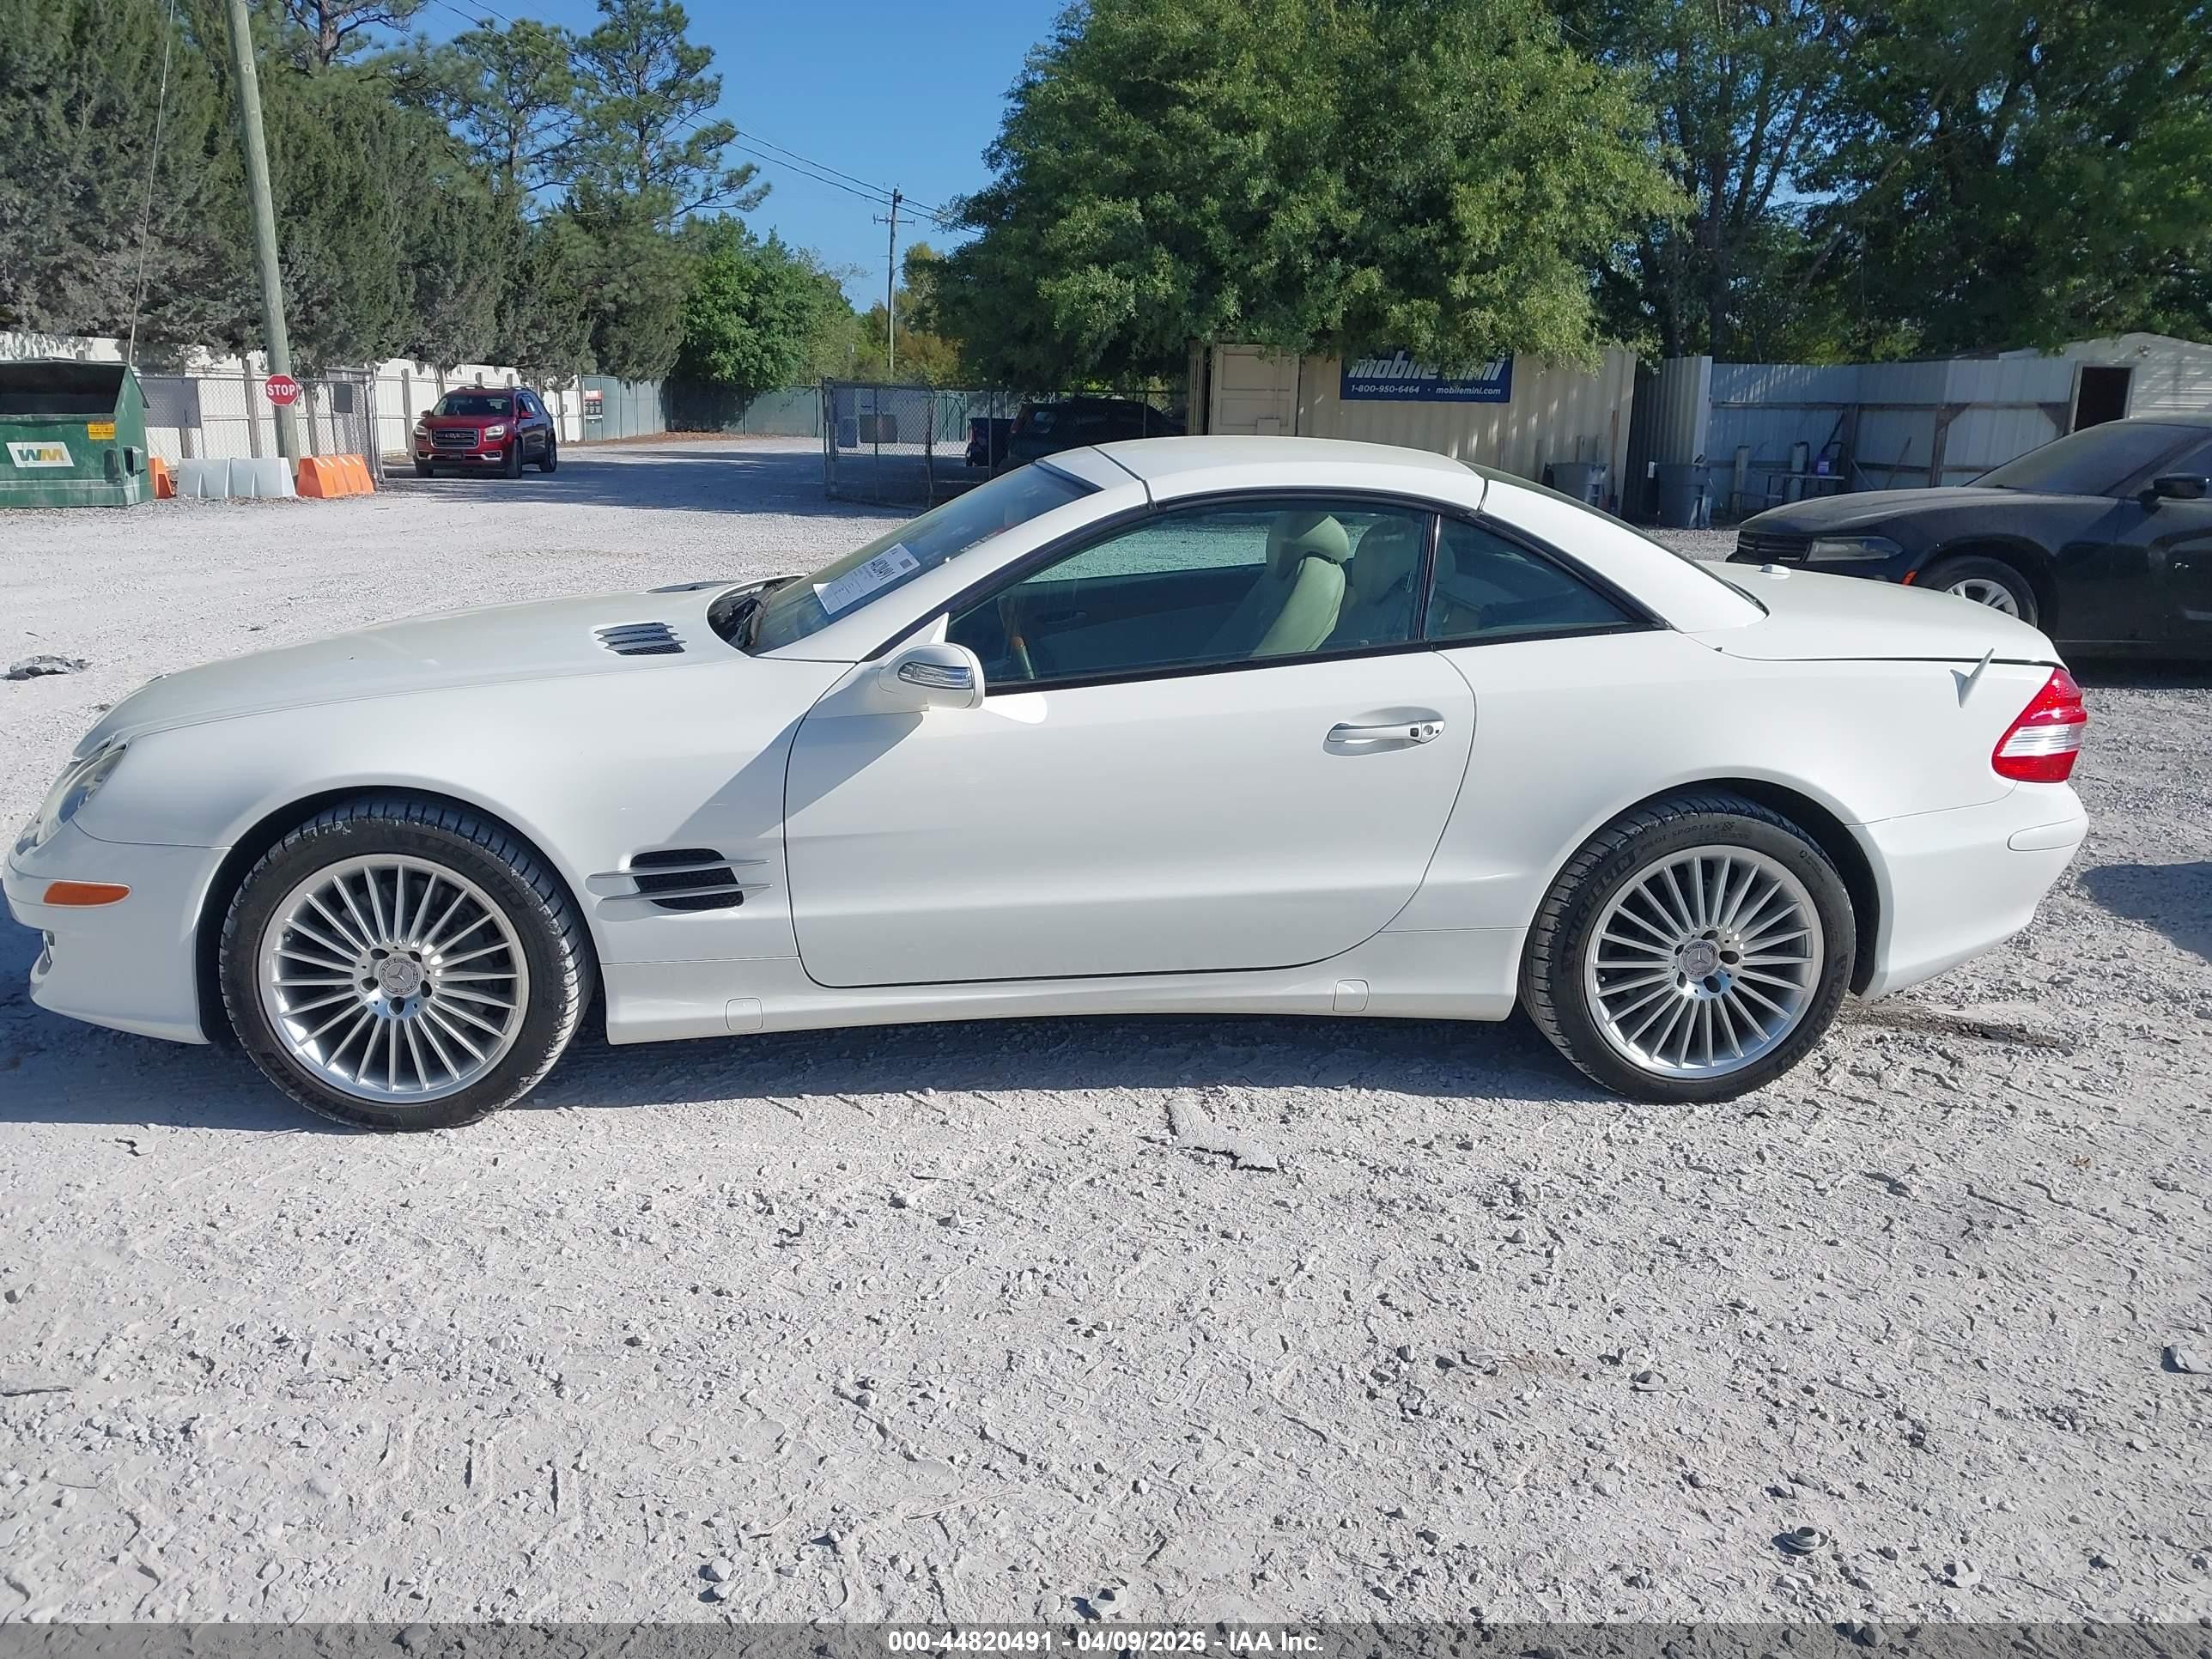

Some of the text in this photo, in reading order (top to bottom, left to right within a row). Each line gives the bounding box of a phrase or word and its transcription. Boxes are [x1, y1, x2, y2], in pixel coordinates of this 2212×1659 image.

[267, 384, 295, 396] STOP
[1351, 384, 1502, 395] 1-800-950-6464 mobilemini.com
[16, 448, 66, 462] WM
